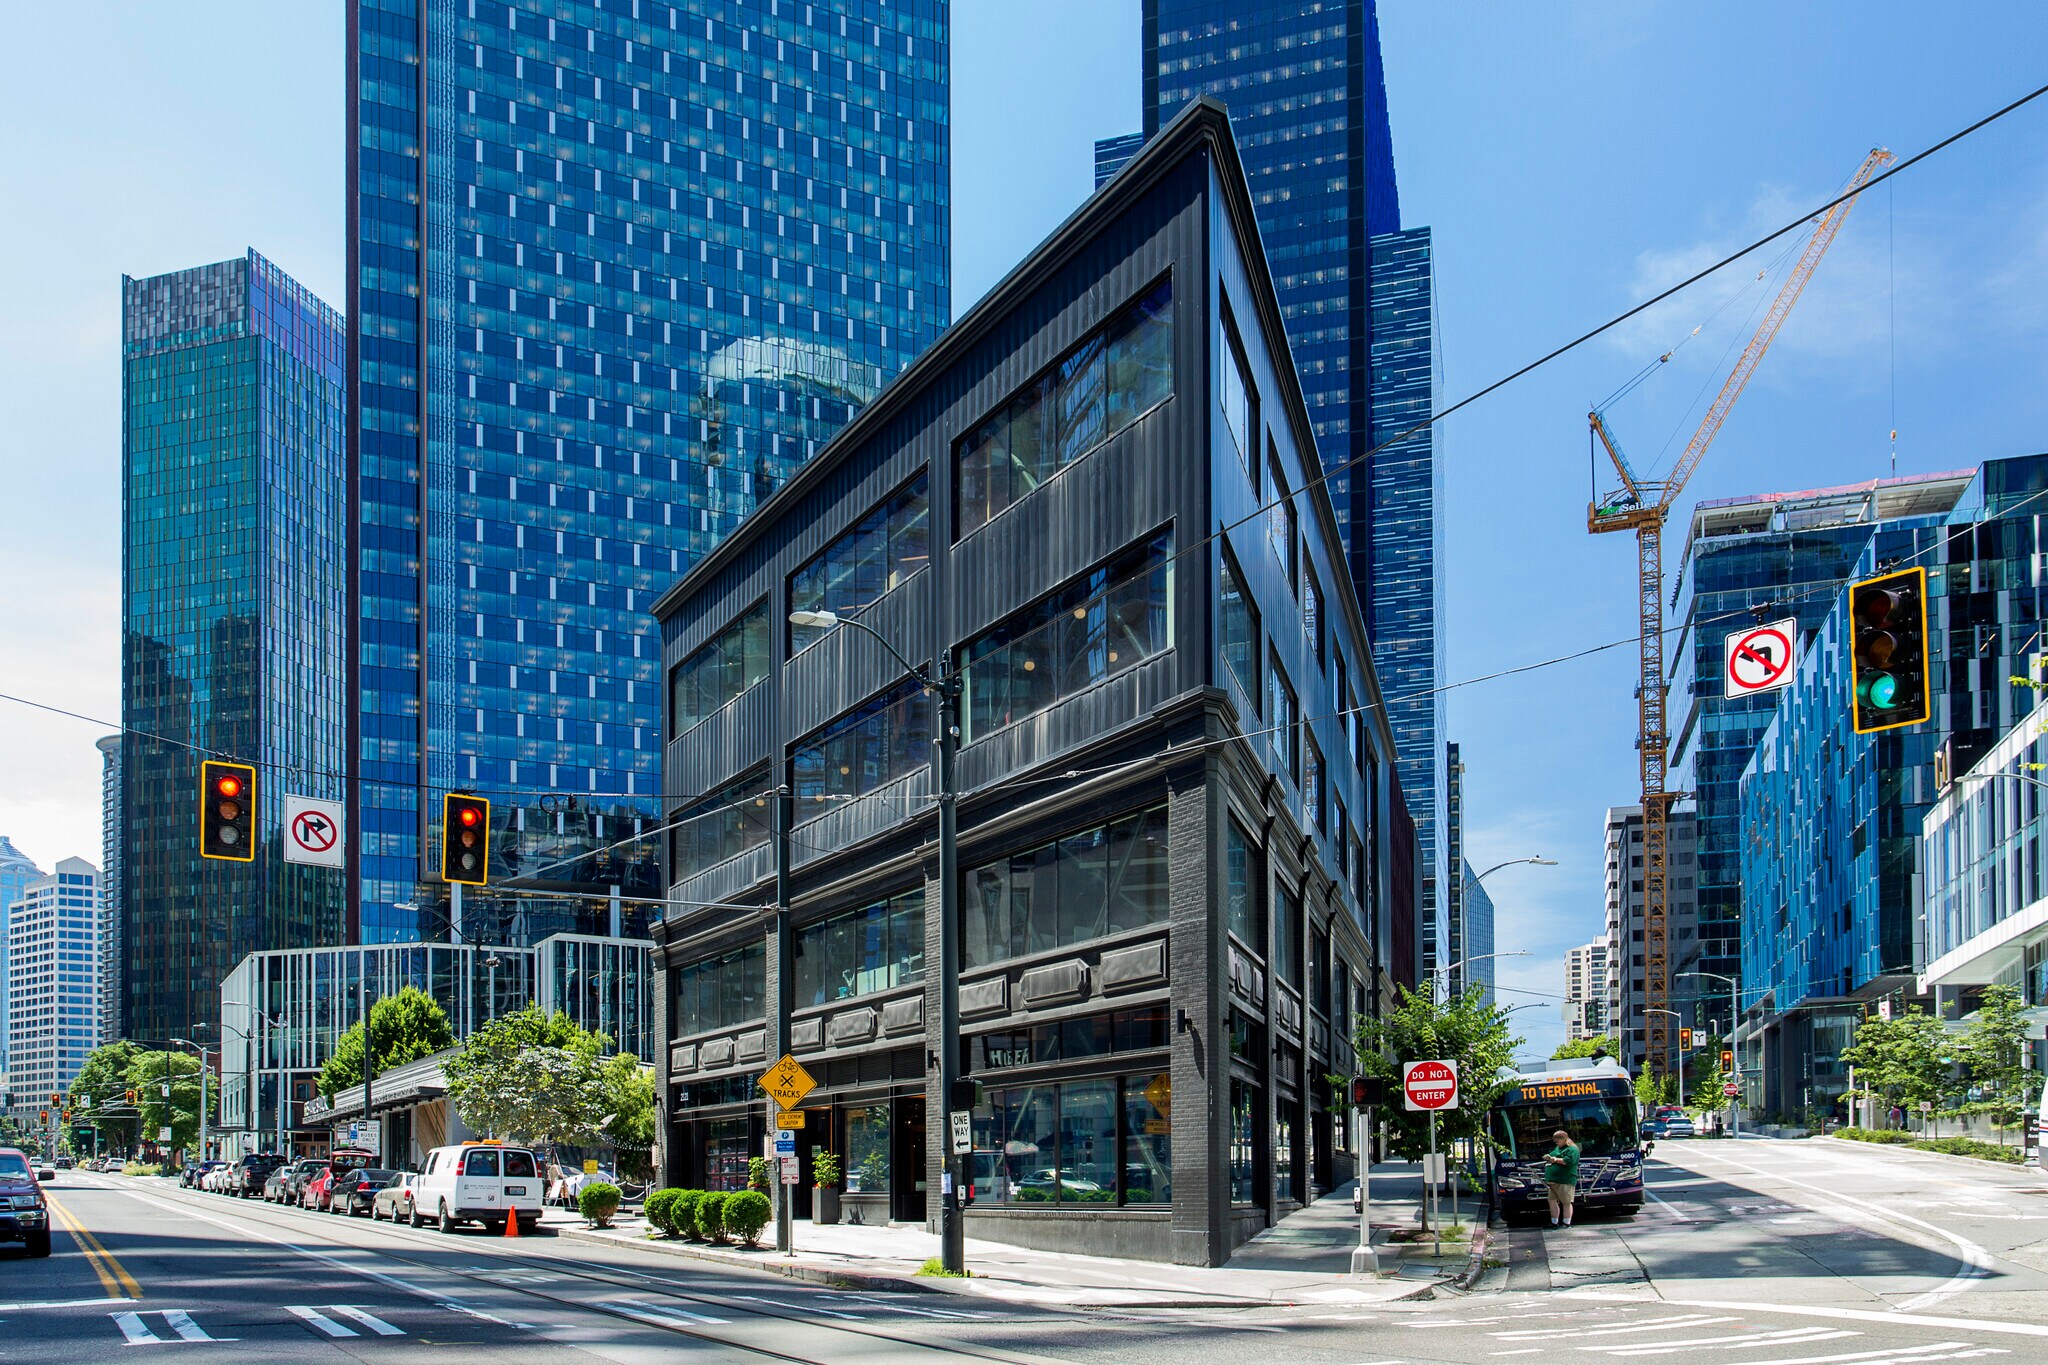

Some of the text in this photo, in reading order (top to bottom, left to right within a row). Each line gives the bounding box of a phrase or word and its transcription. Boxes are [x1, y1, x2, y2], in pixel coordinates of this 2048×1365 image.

[1412, 1070, 1448, 1079] DO NOT
[773, 1089, 801, 1099] TRACKS
[1521, 1082, 1601, 1099] TO TERMINAL
[1416, 1091, 1445, 1100] ENTER
[953, 1115, 968, 1125] ONE
[954, 1127, 968, 1136] WAY
